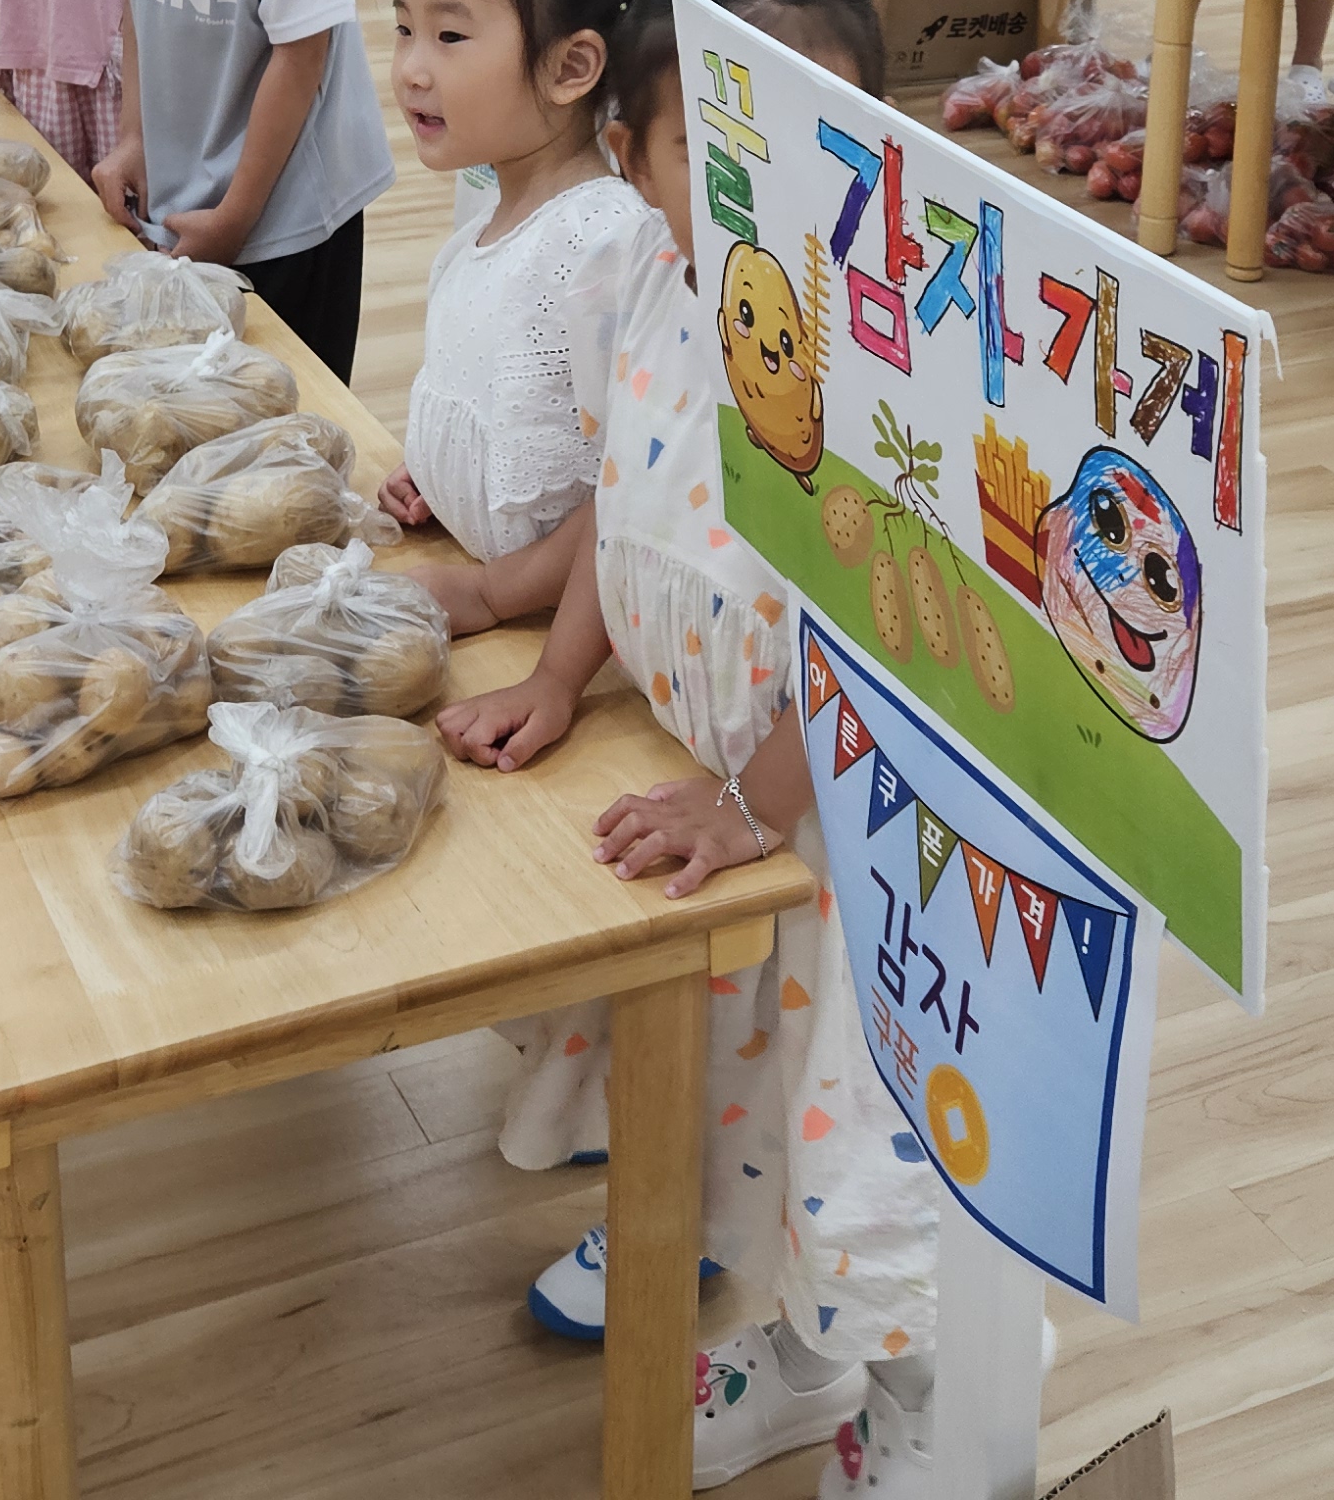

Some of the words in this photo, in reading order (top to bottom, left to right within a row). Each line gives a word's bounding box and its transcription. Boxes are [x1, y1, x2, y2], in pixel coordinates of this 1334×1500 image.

[946, 11, 1028, 39] 로켓배송
[870, 865, 980, 1056] 감자
[871, 986, 921, 1100] 쿠폰
